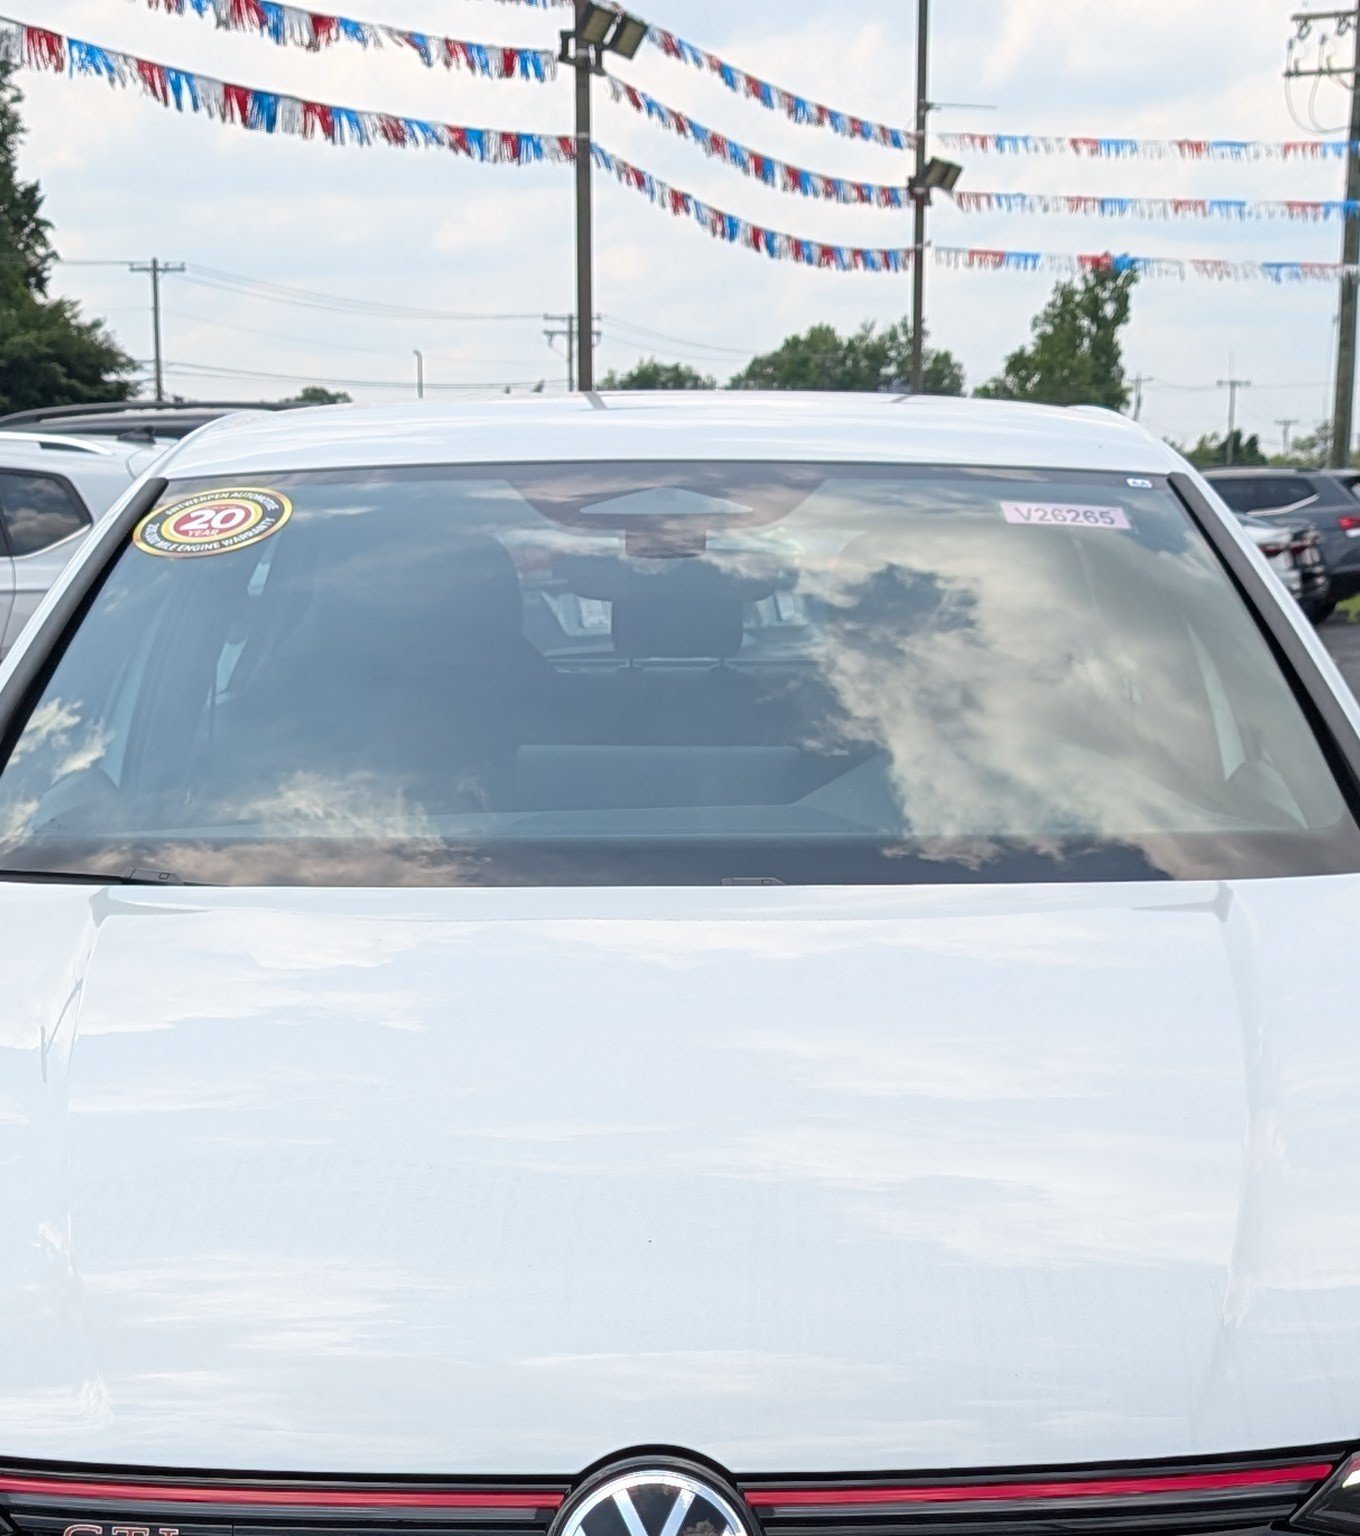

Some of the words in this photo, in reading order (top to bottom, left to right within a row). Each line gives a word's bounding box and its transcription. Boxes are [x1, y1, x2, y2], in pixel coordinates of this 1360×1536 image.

[178, 508, 246, 531] 20
[1014, 507, 1116, 526] V26265
[188, 529, 220, 537] YEAR
